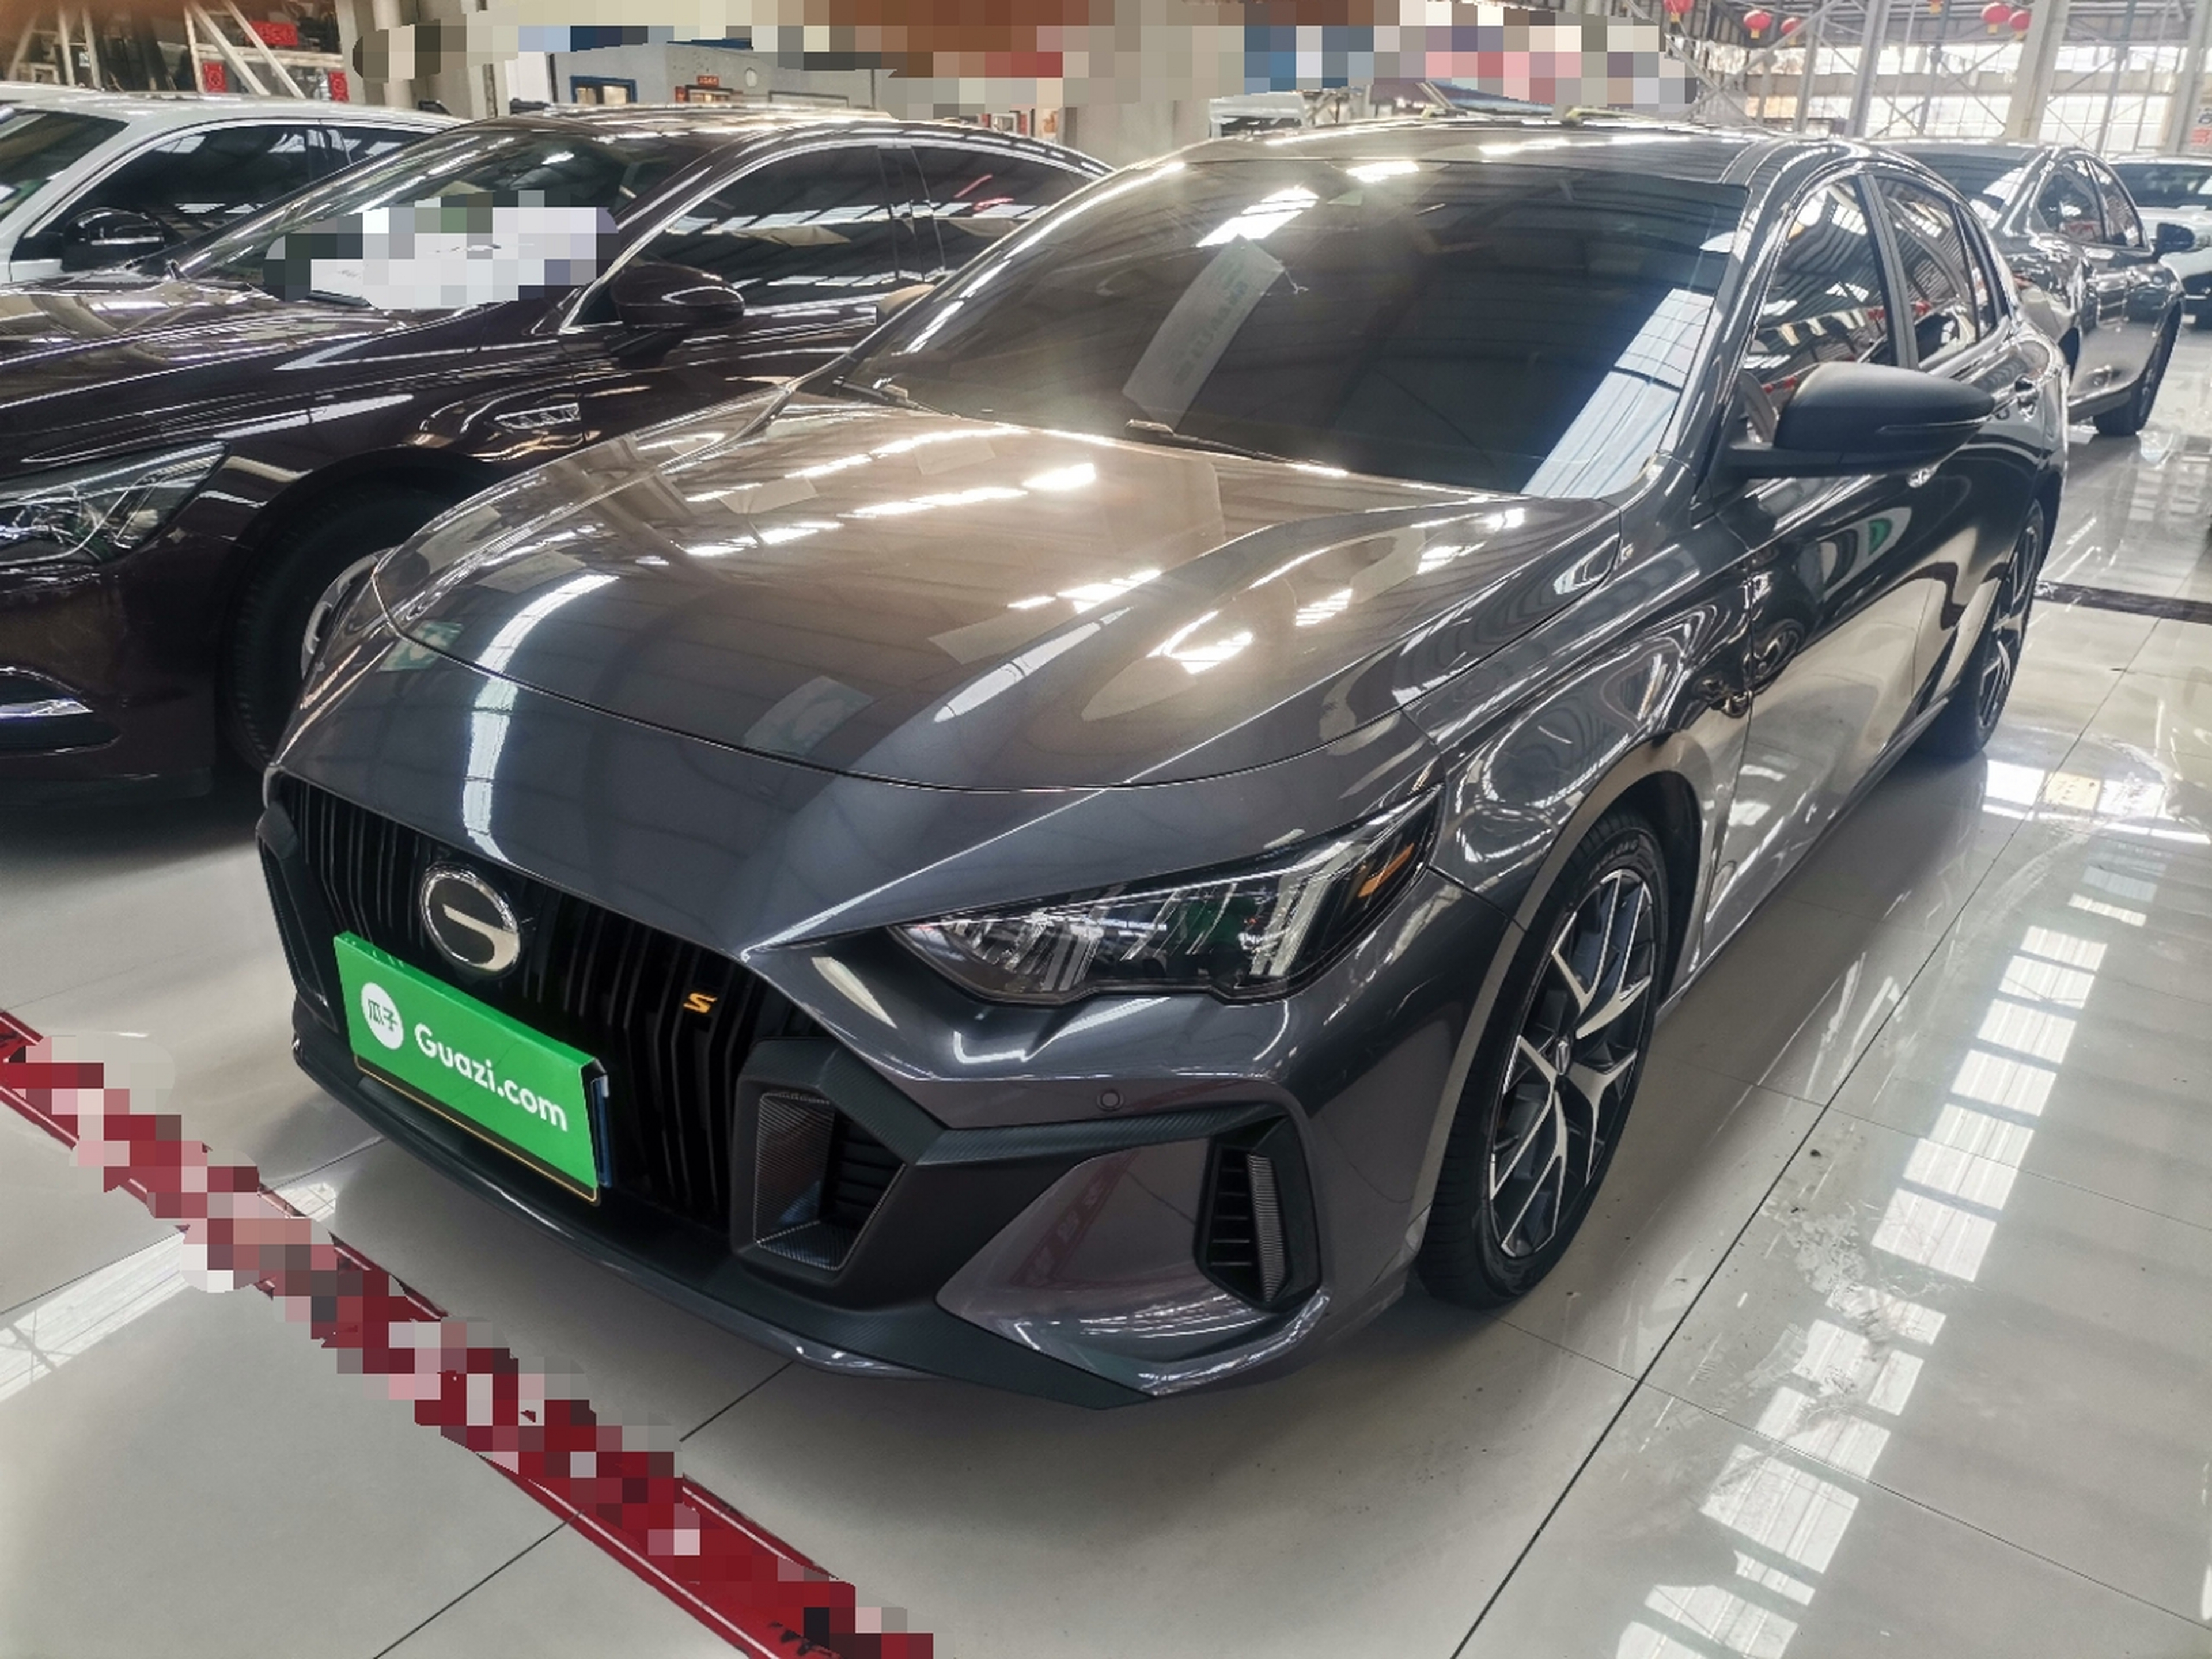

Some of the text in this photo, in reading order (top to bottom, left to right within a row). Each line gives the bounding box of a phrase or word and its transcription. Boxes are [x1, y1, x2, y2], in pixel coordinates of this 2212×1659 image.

[368, 998, 399, 1032] 瓜子
[684, 993, 717, 1013] S
[415, 1023, 567, 1131] Guazi.com
